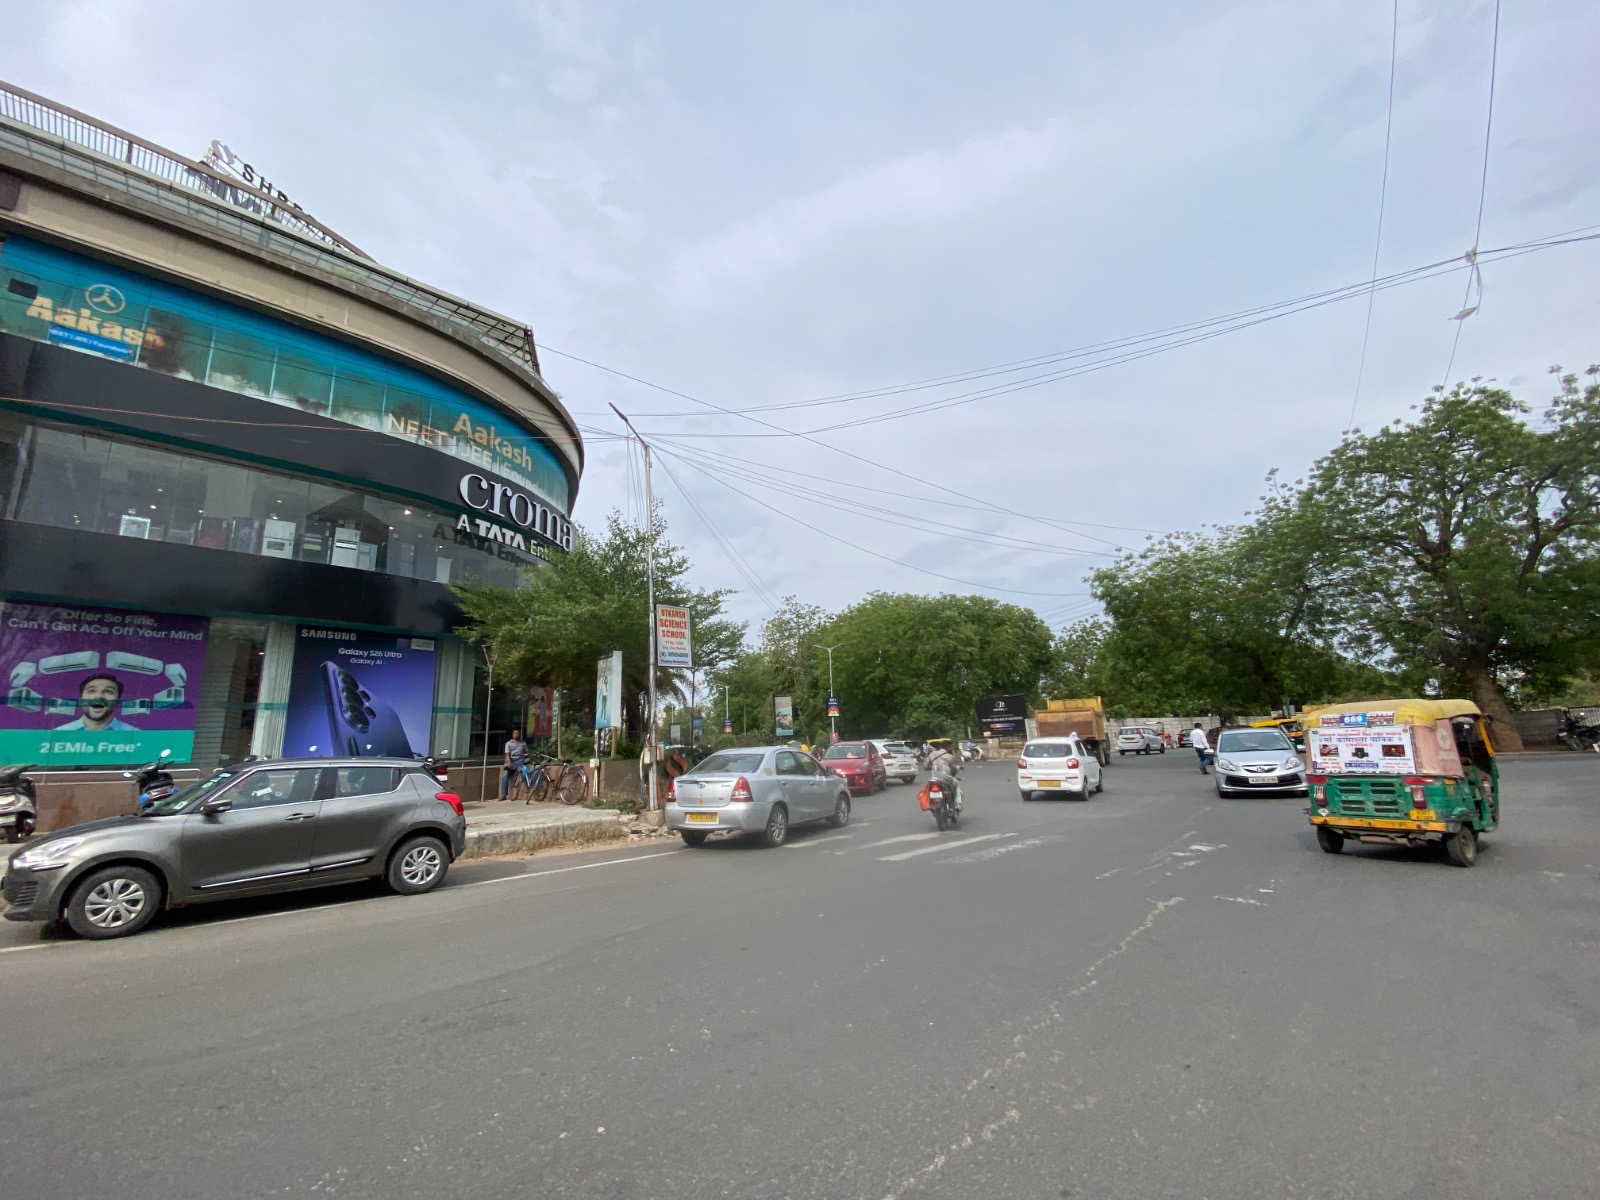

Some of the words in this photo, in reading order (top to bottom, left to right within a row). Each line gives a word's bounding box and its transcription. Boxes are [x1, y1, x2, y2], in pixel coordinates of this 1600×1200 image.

[26, 295, 165, 349] Aakash
[388, 412, 449, 448] NEET
[461, 442, 492, 467] JEE
[453, 412, 532, 472] Aakash
[459, 473, 573, 552] croma
[457, 514, 471, 532] A
[475, 518, 526, 550] TATA
[62, 609, 102, 622] Offer
[104, 613, 122, 624] So
[125, 615, 158, 627] Fine,
[660, 608, 686, 619] UTKARSH
[8, 618, 48, 630] Can't
[51, 622, 77, 632] Get
[80, 623, 110, 634] ACs
[112, 625, 134, 636] Off
[136, 627, 168, 639] Your
[170, 630, 204, 641] Mind
[660, 618, 688, 630] SCIENCE
[301, 628, 357, 641] SAMSUNG
[661, 629, 686, 640] SCHOOL
[338, 647, 368, 657] Galaxy
[369, 649, 383, 657] S26
[384, 649, 402, 659] Ultra
[350, 657, 375, 666] Galaxy
[1343, 715, 1363, 723] 669
[39, 742, 50, 754] 2
[53, 742, 95, 753] EMIs
